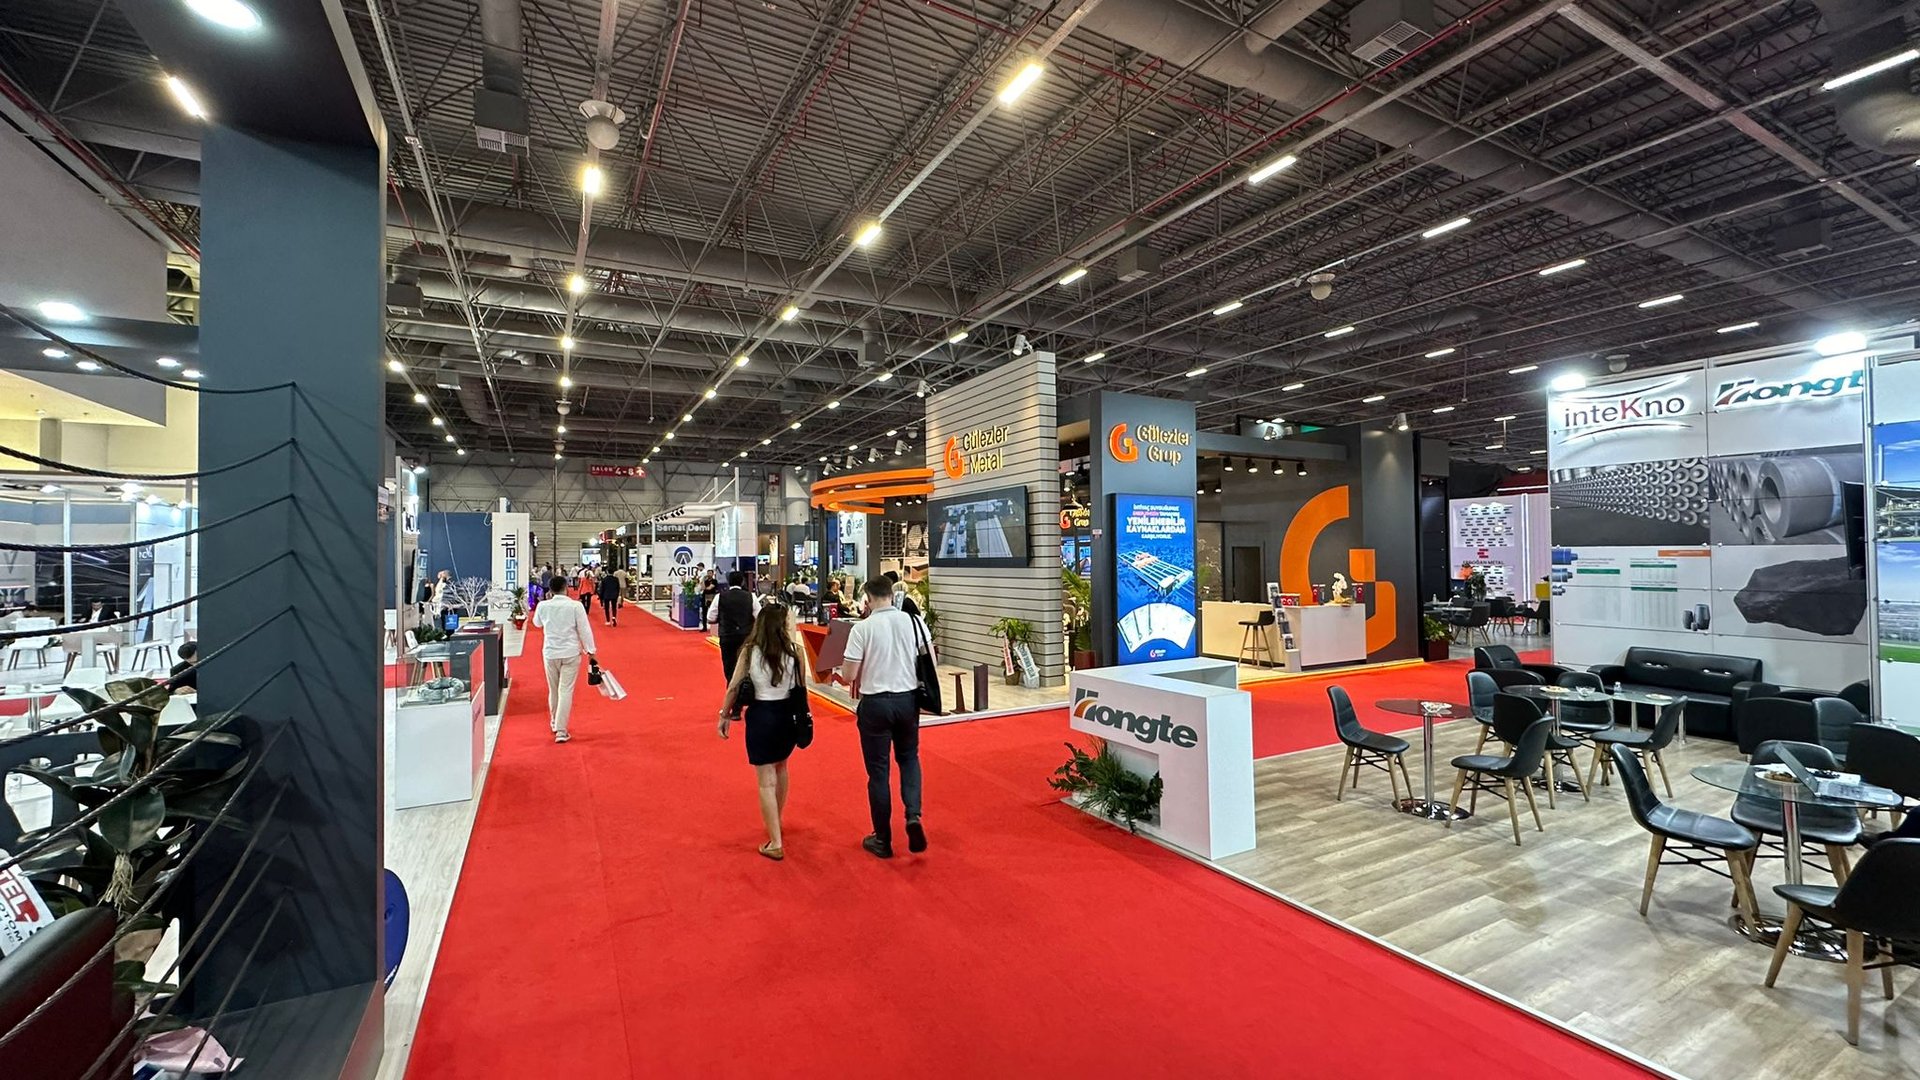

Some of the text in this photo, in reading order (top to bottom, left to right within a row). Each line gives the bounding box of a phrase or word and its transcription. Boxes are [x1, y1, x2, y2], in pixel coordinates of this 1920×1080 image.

[1564, 396, 1686, 428] inteKno
[962, 425, 1009, 452] Gülezler
[1136, 423, 1192, 446] Gülezler
[969, 448, 1003, 475] Metal
[1147, 444, 1183, 467] Grup
